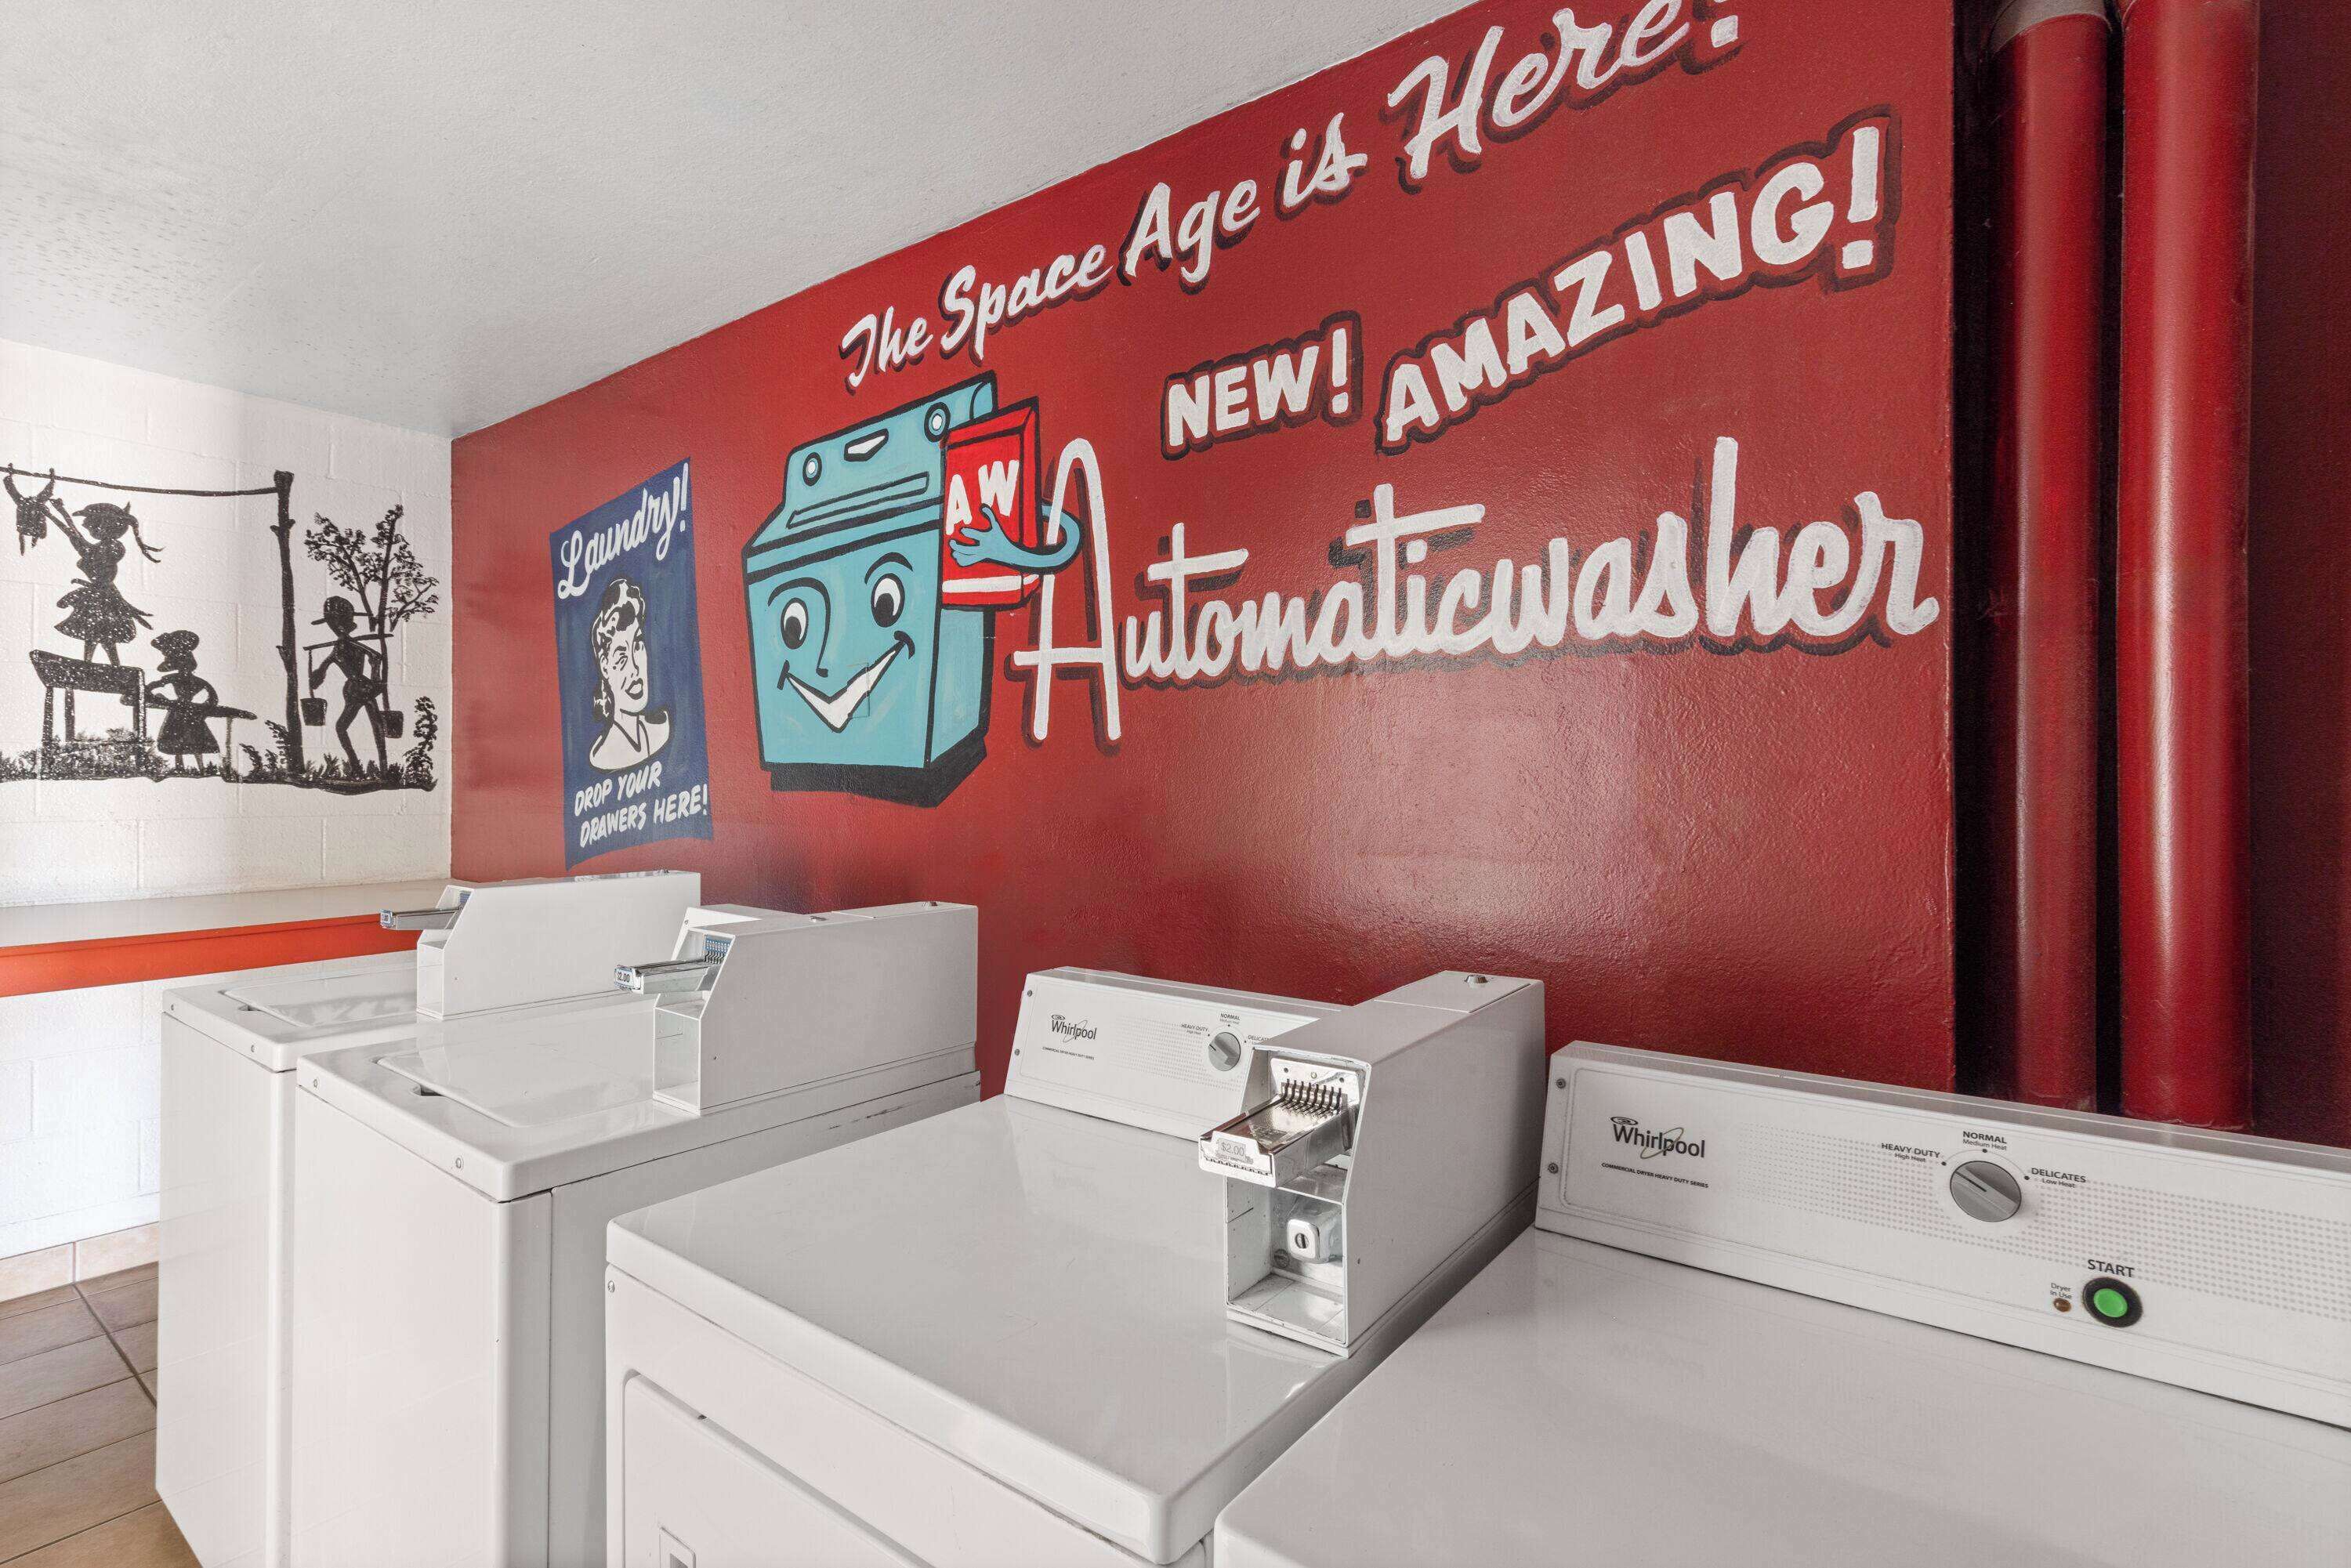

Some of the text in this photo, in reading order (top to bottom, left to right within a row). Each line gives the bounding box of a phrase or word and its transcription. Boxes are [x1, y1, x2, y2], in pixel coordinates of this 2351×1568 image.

[841, 0, 1738, 388] The Space Age is Here
[1386, 125, 1880, 442] AMAZING!
[1166, 328, 1349, 447] NEW!
[557, 462, 689, 599] Laundry!
[1013, 436, 1940, 741] Automaticwasher
[574, 760, 662, 817] DROP YOUR
[580, 784, 708, 849] DRAWERS HERE!
[1220, 1012, 1241, 1021] NORMAL
[1051, 1019, 1097, 1041] Whirlpool
[1613, 1124, 1705, 1158] Whirlpool
[1962, 1131, 2007, 1144] NORMAL
[1962, 1139, 1991, 1148] Medium
[1221, 1142, 1244, 1157] $2.00
[1881, 1143, 1940, 1158] HEAVY DUTY
[1601, 1162, 1636, 1174] COMMERCIAL
[1636, 1169, 1654, 1178] DRYER
[1690, 1180, 1709, 1189] SERIES
[2031, 1168, 2086, 1183] DELICATES
[2058, 1180, 2077, 1189] Heat
[2087, 1258, 2135, 1278] START
[2050, 1282, 2071, 1291] Dryer
